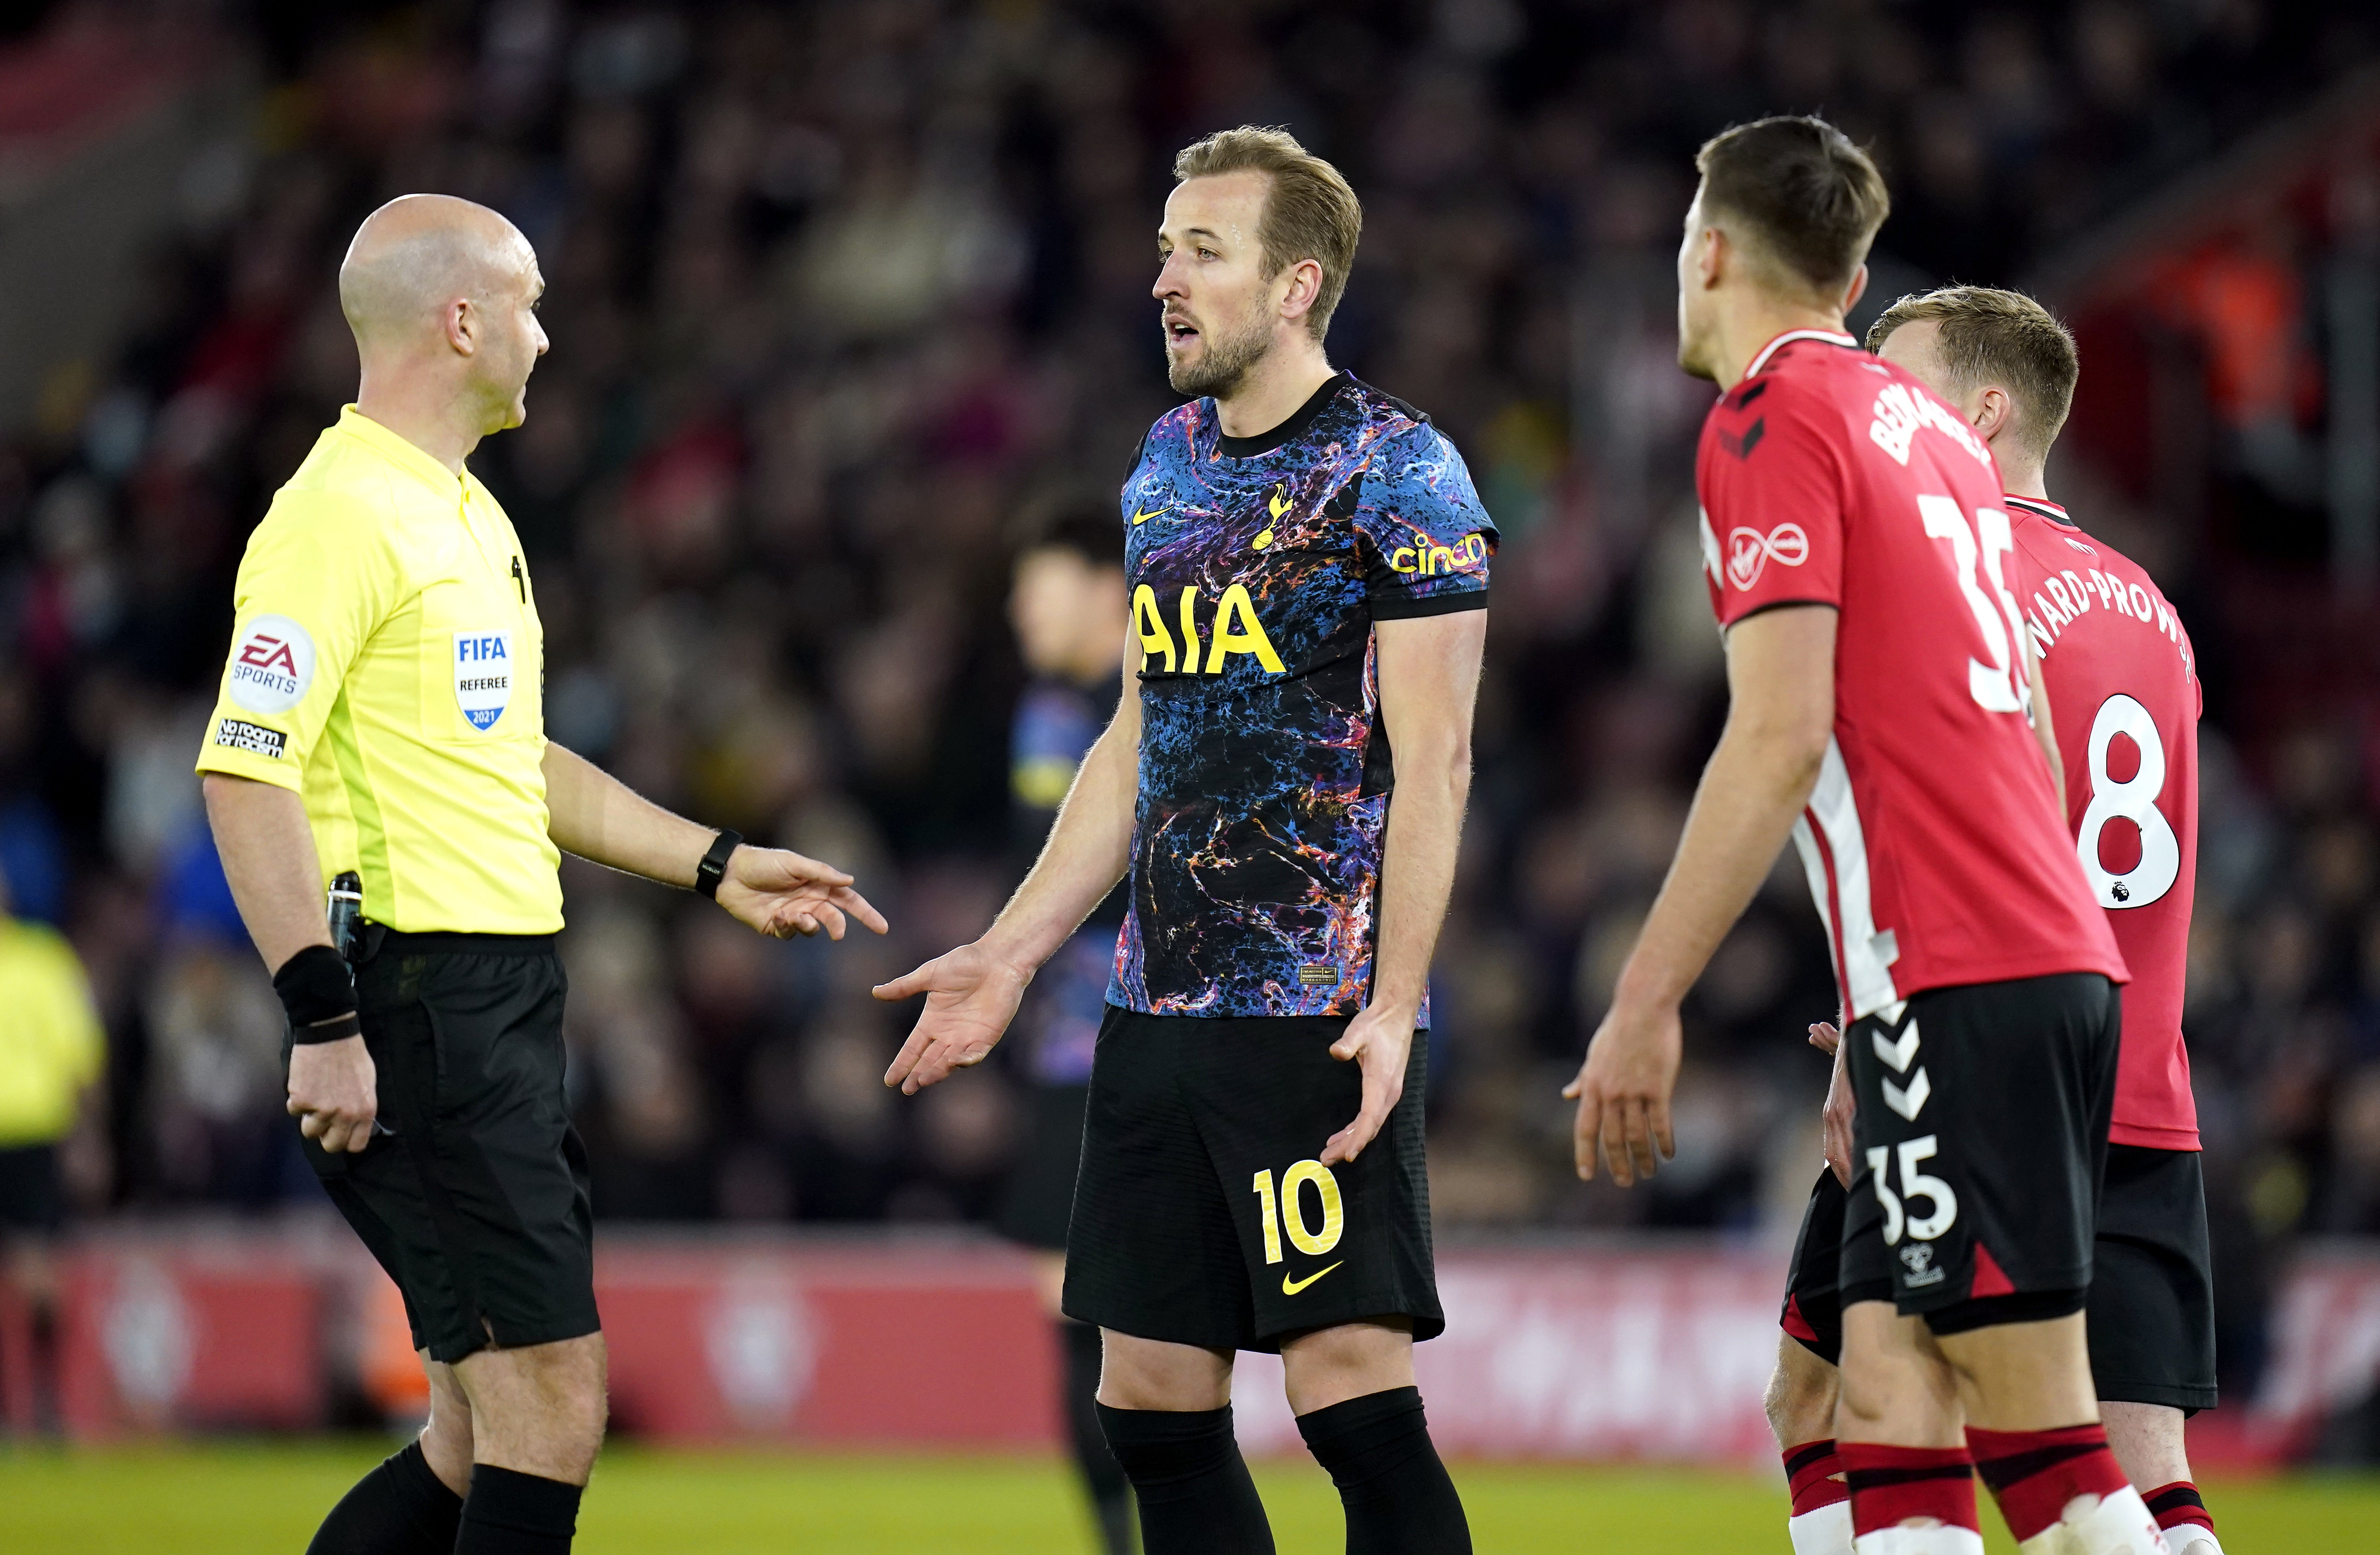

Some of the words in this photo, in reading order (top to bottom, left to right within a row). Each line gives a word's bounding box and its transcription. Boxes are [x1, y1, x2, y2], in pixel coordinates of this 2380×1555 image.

[1133, 584, 1287, 674] AIA
[238, 633, 297, 677] EA
[459, 637, 506, 661] FIFA
[234, 665, 297, 694] SPORTS
[460, 676, 508, 692] REFEREE
[218, 717, 238, 735] No
[238, 722, 280, 747] room
[473, 710, 495, 724] 2021
[214, 731, 236, 746] for
[234, 734, 283, 760] racism
[2077, 693, 2180, 910] 8
[1866, 1134, 1958, 1246] 35
[1253, 1159, 1344, 1264] 10
